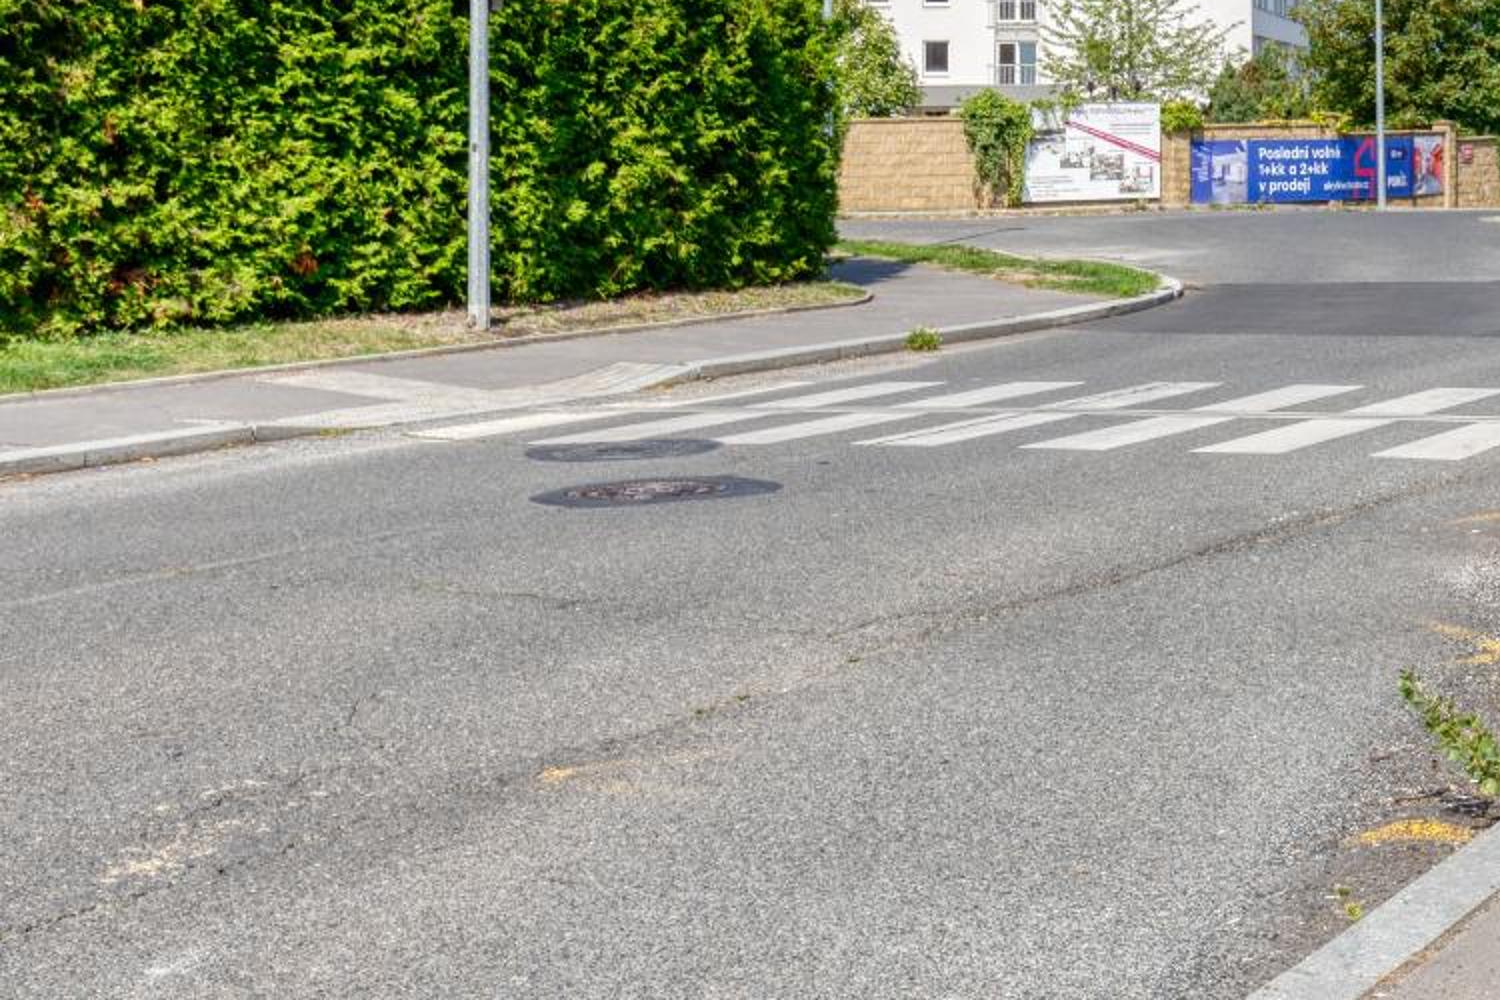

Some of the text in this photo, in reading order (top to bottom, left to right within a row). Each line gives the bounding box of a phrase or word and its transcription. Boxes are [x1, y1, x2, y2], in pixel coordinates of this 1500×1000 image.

[1258, 145, 1309, 160] Poslední
[1289, 164, 1297, 175] a
[1299, 161, 1329, 175] 2+kk
[1259, 181, 1267, 191] v
[1269, 177, 1311, 195] prodeji
